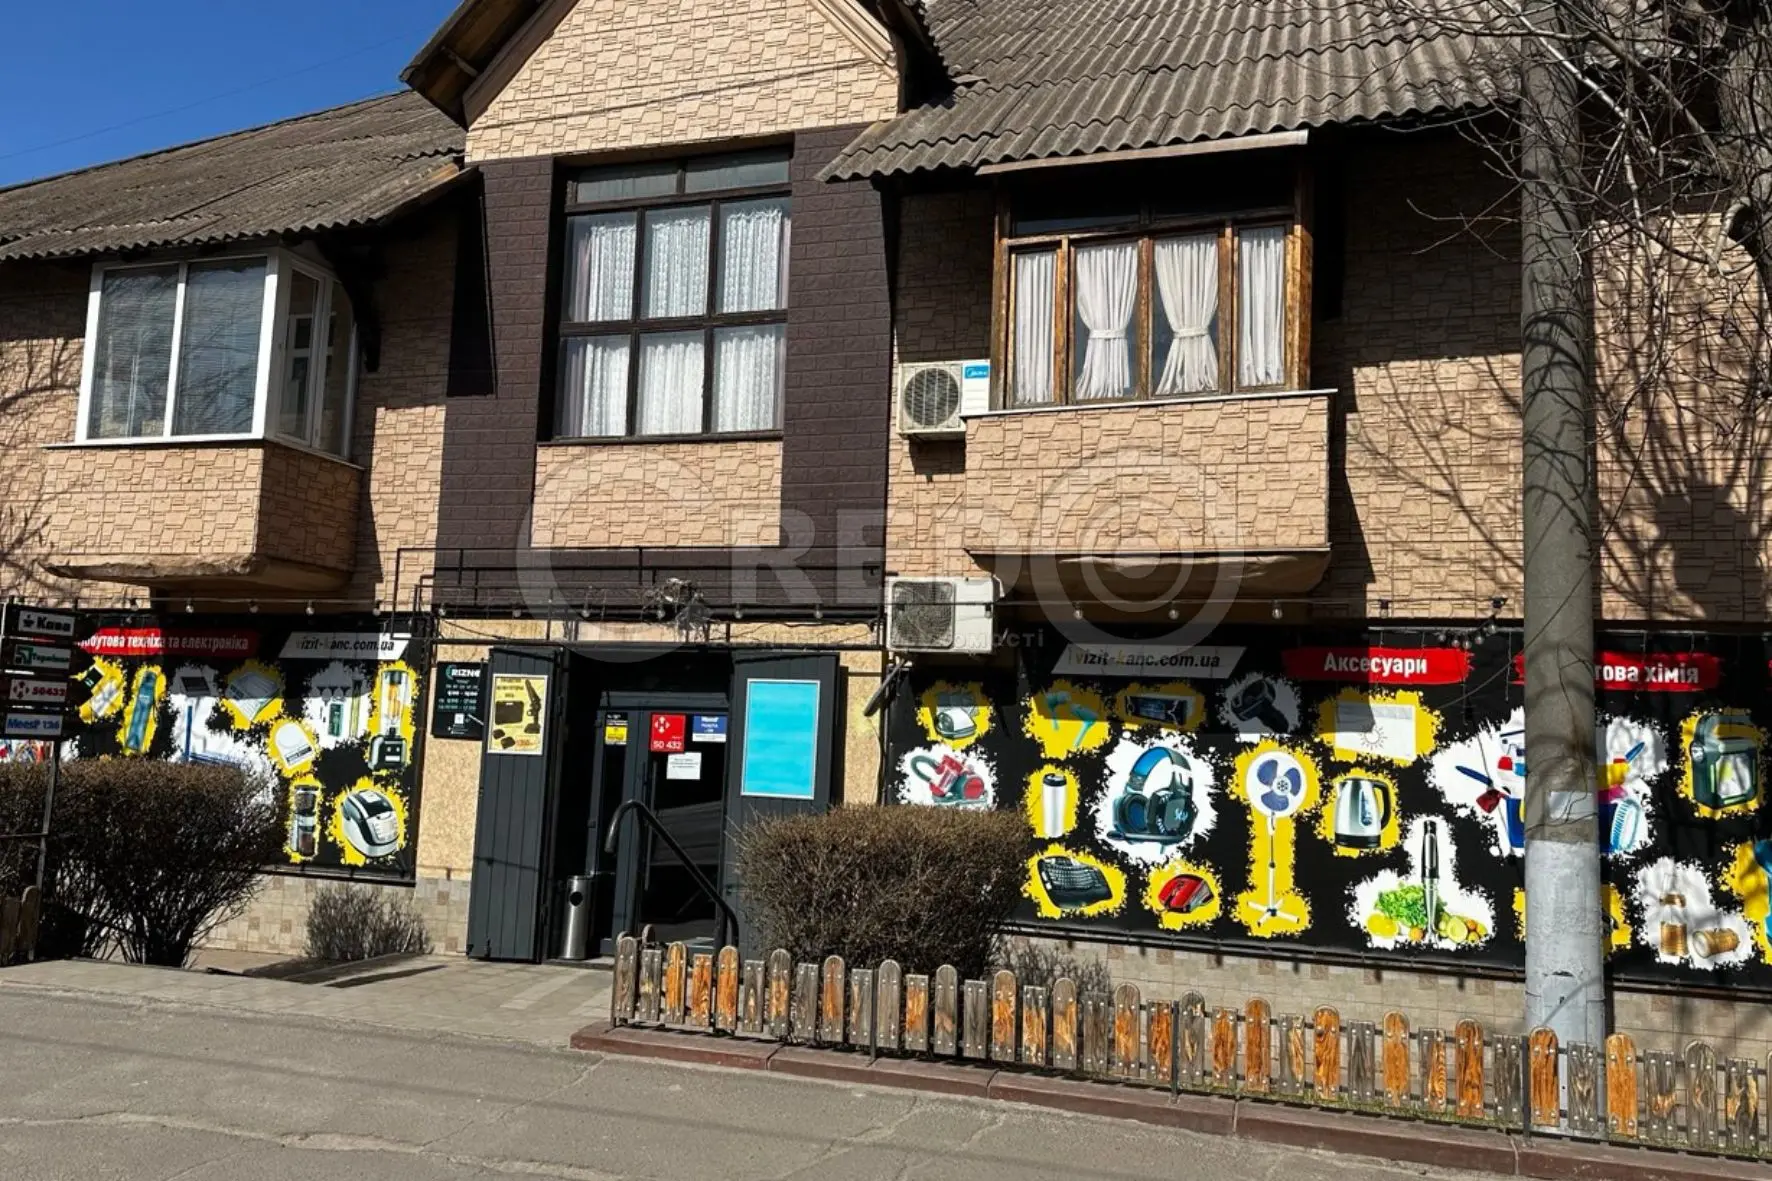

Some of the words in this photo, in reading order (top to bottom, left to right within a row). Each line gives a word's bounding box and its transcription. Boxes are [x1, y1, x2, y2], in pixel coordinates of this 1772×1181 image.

[37, 616, 71, 631] Кава
[127, 633, 165, 648] техніка
[168, 636, 180, 648] та
[180, 634, 249, 653] електроніка
[1074, 649, 1221, 668] vizit-kanc.com.ua
[1323, 652, 1428, 678] Аксесуари
[1644, 662, 1700, 684] хімія
